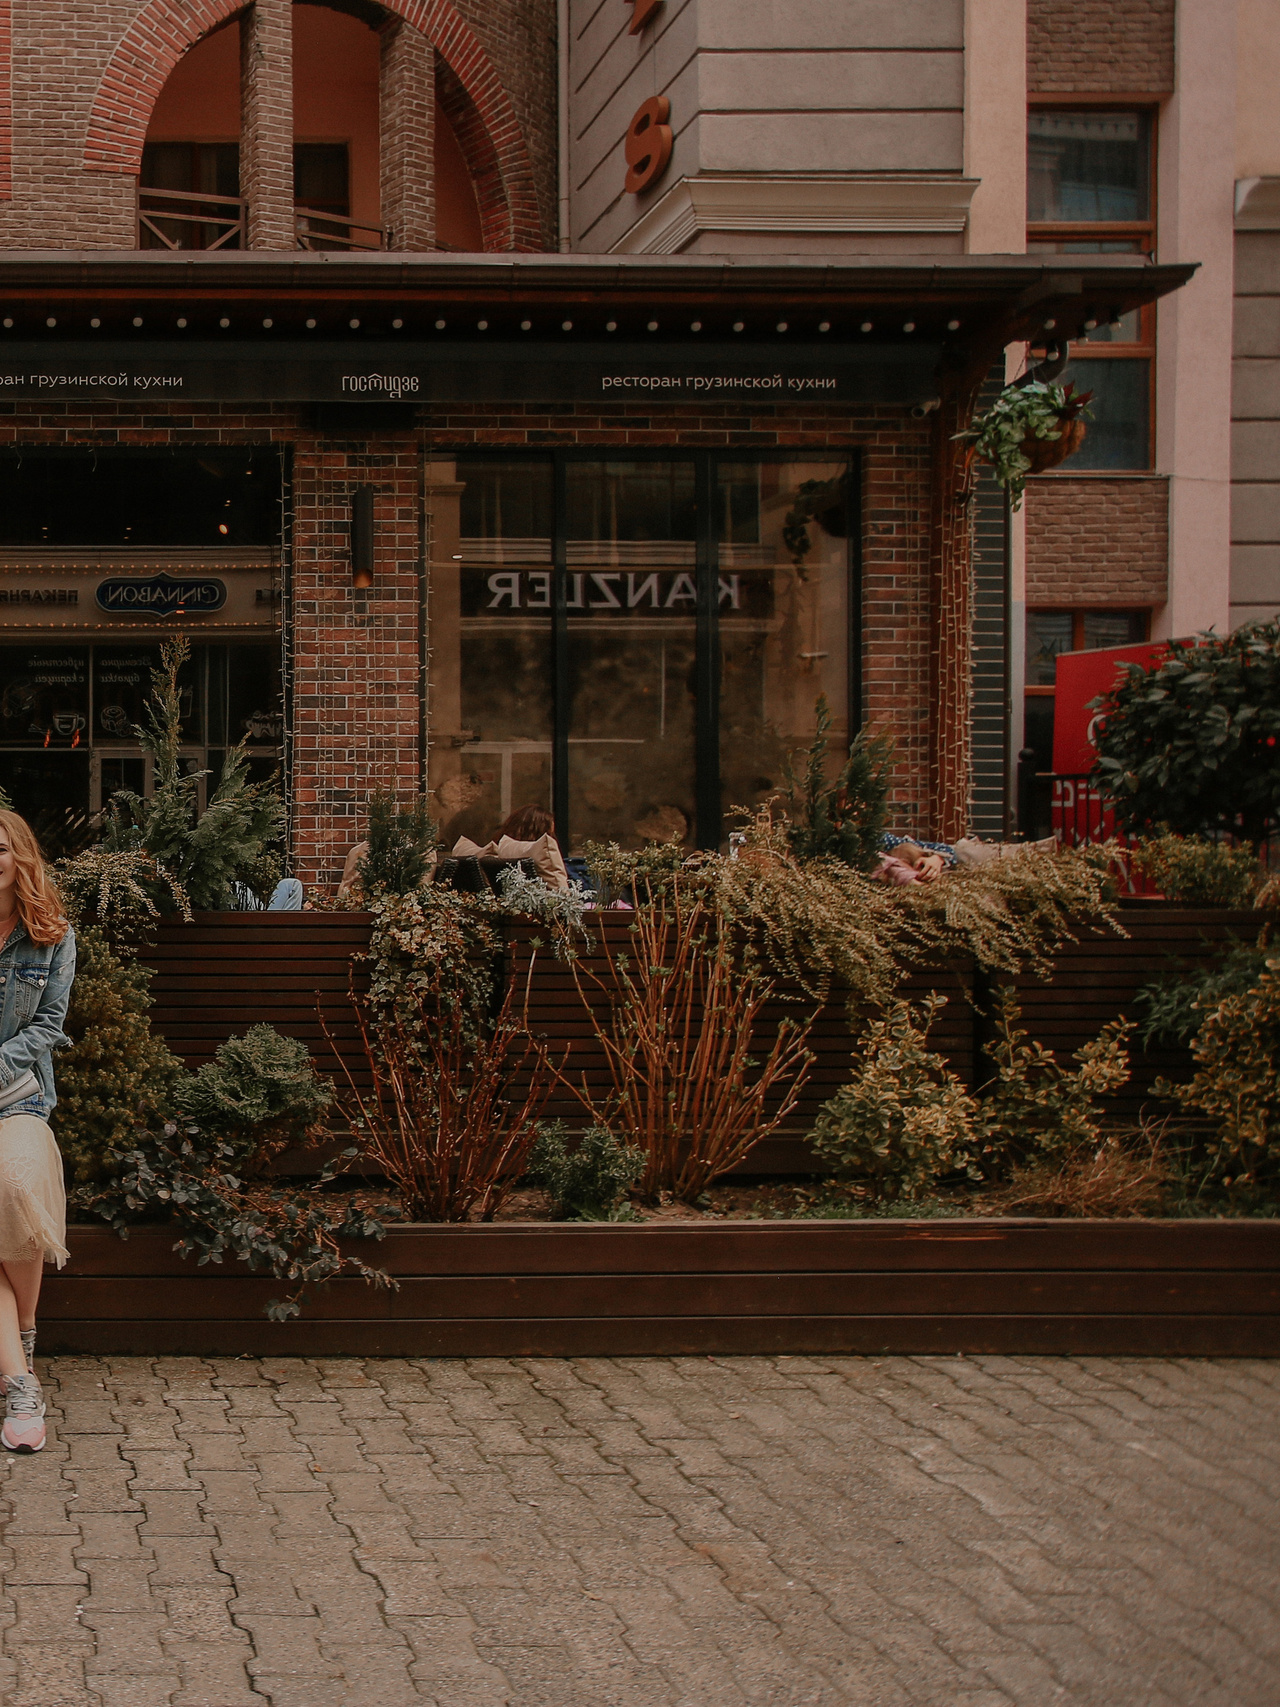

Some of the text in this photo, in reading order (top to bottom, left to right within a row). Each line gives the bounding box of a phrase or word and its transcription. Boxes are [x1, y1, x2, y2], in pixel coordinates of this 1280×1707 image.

[30, 372, 127, 389] грузинской
[133, 376, 183, 390] кухни
[602, 374, 836, 391] ресторан грузинской кухни
